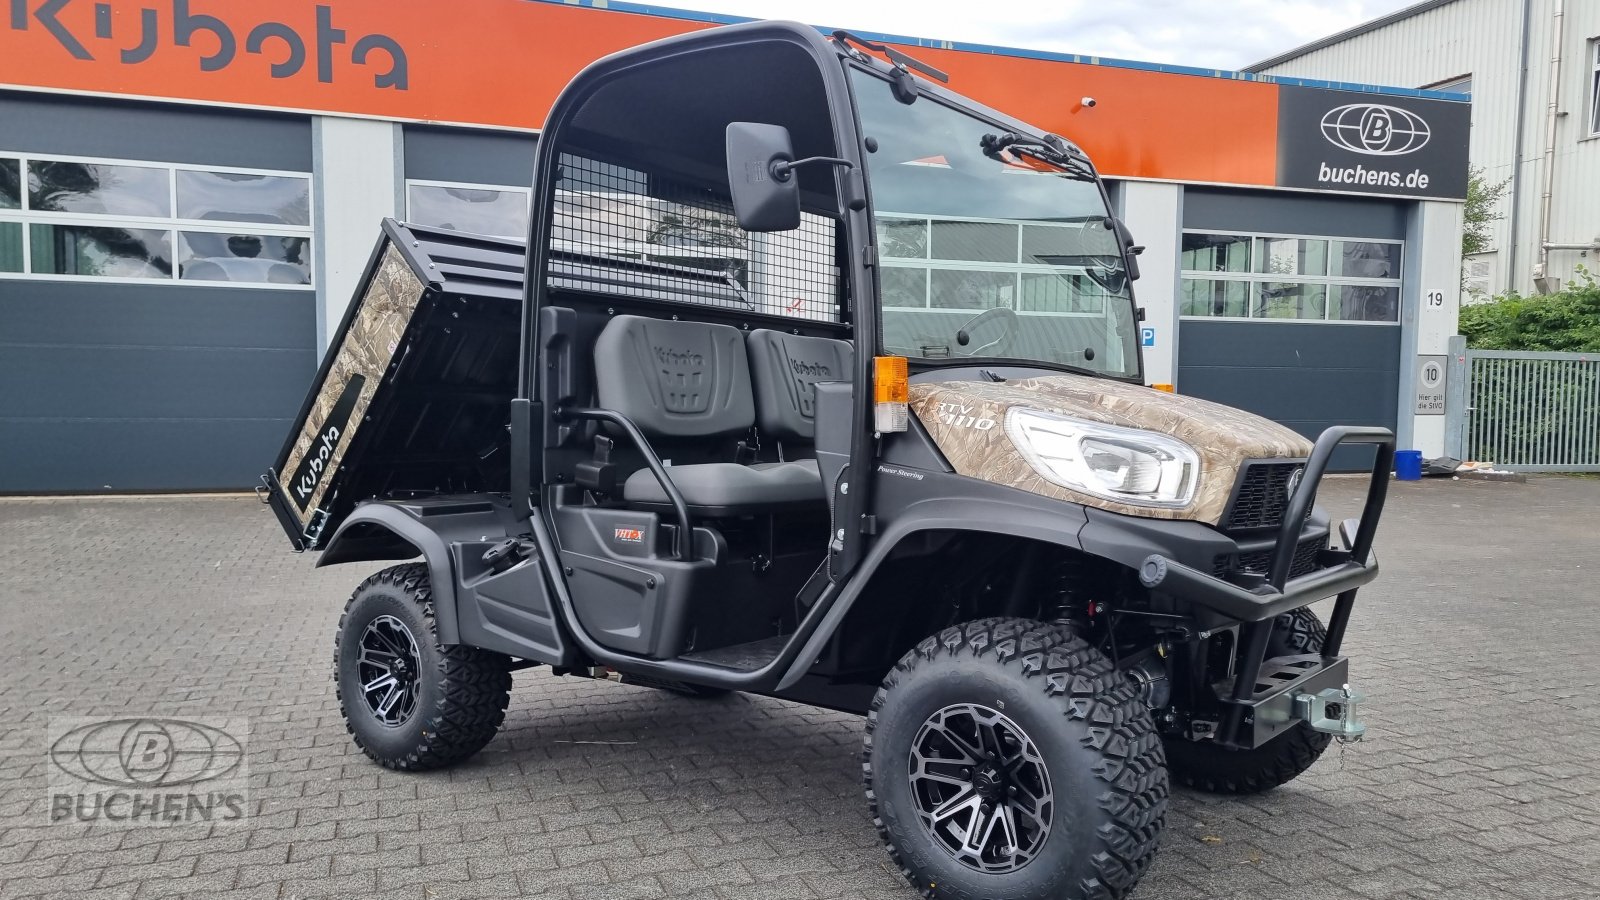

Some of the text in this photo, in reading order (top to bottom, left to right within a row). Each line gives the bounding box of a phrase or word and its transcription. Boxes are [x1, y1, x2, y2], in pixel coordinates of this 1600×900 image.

[11, 0, 409, 91] Kubota
[1318, 162, 1429, 189] buchens.de
[1427, 292, 1443, 306] 19
[1142, 329, 1153, 345] P
[1426, 368, 1437, 381] 10
[296, 426, 340, 499] Kubota
[877, 465, 924, 481] Power Steering
